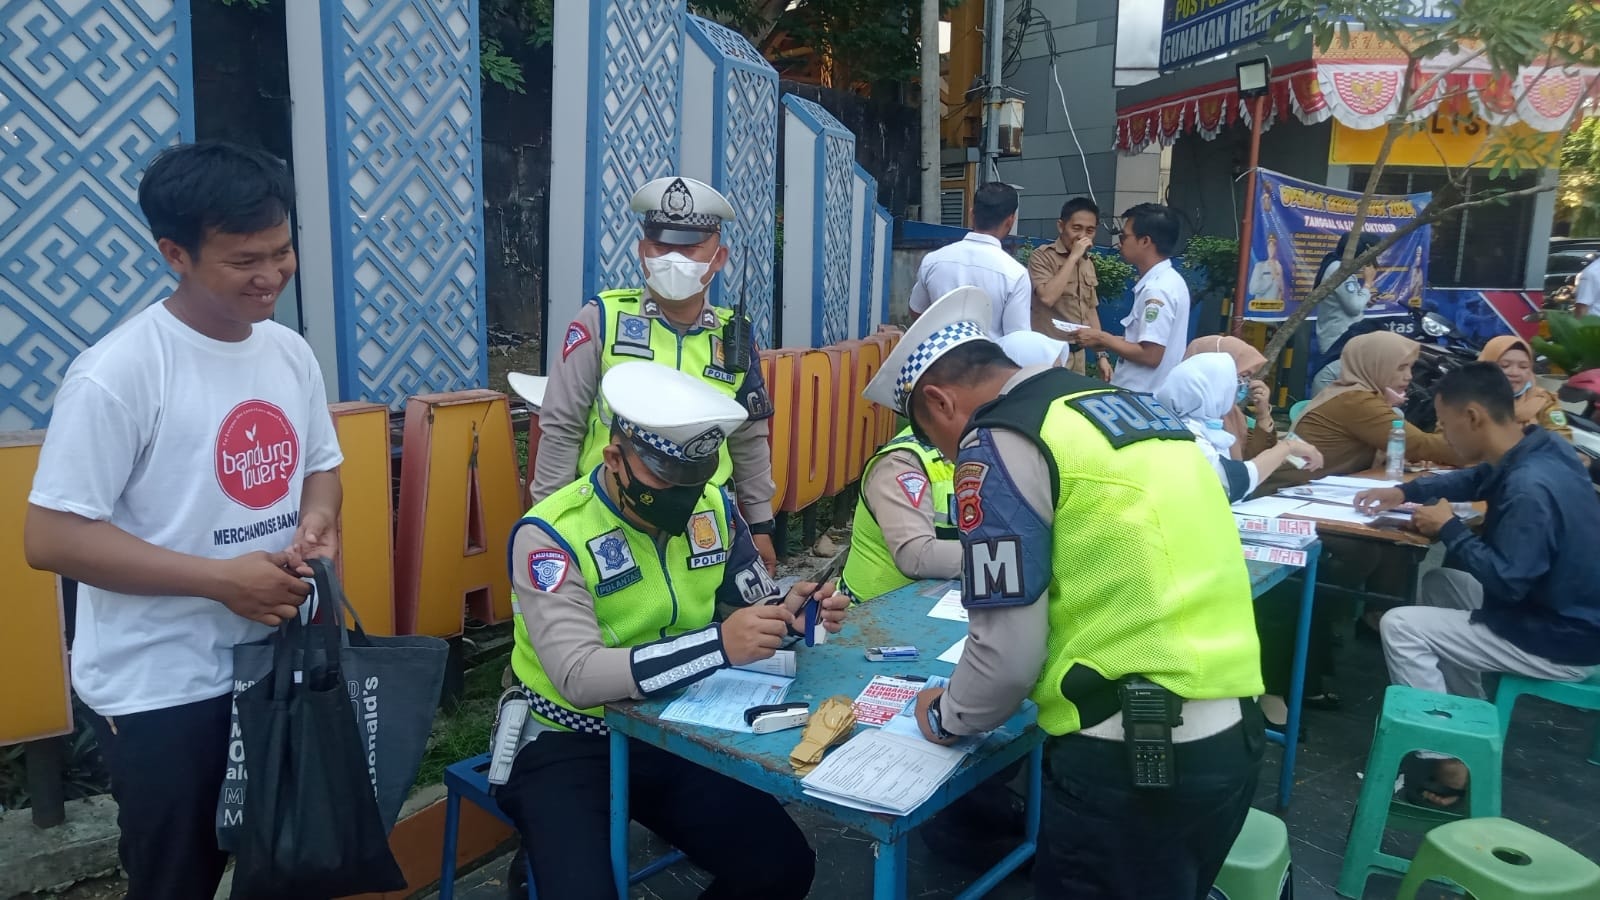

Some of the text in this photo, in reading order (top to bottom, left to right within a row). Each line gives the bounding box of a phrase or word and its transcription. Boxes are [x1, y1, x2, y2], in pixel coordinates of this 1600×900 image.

[1162, 13, 1227, 66] GUNAKAN
[1304, 215, 1337, 229] TANGGAL
[1365, 221, 1397, 233] OKTOBER
[707, 369, 735, 382] POLRI
[222, 440, 292, 474] bandung
[213, 516, 277, 546] MERCHANDISE
[693, 553, 725, 568] POLRI
[971, 540, 1020, 597] M
[599, 570, 641, 594] POLANTAS
